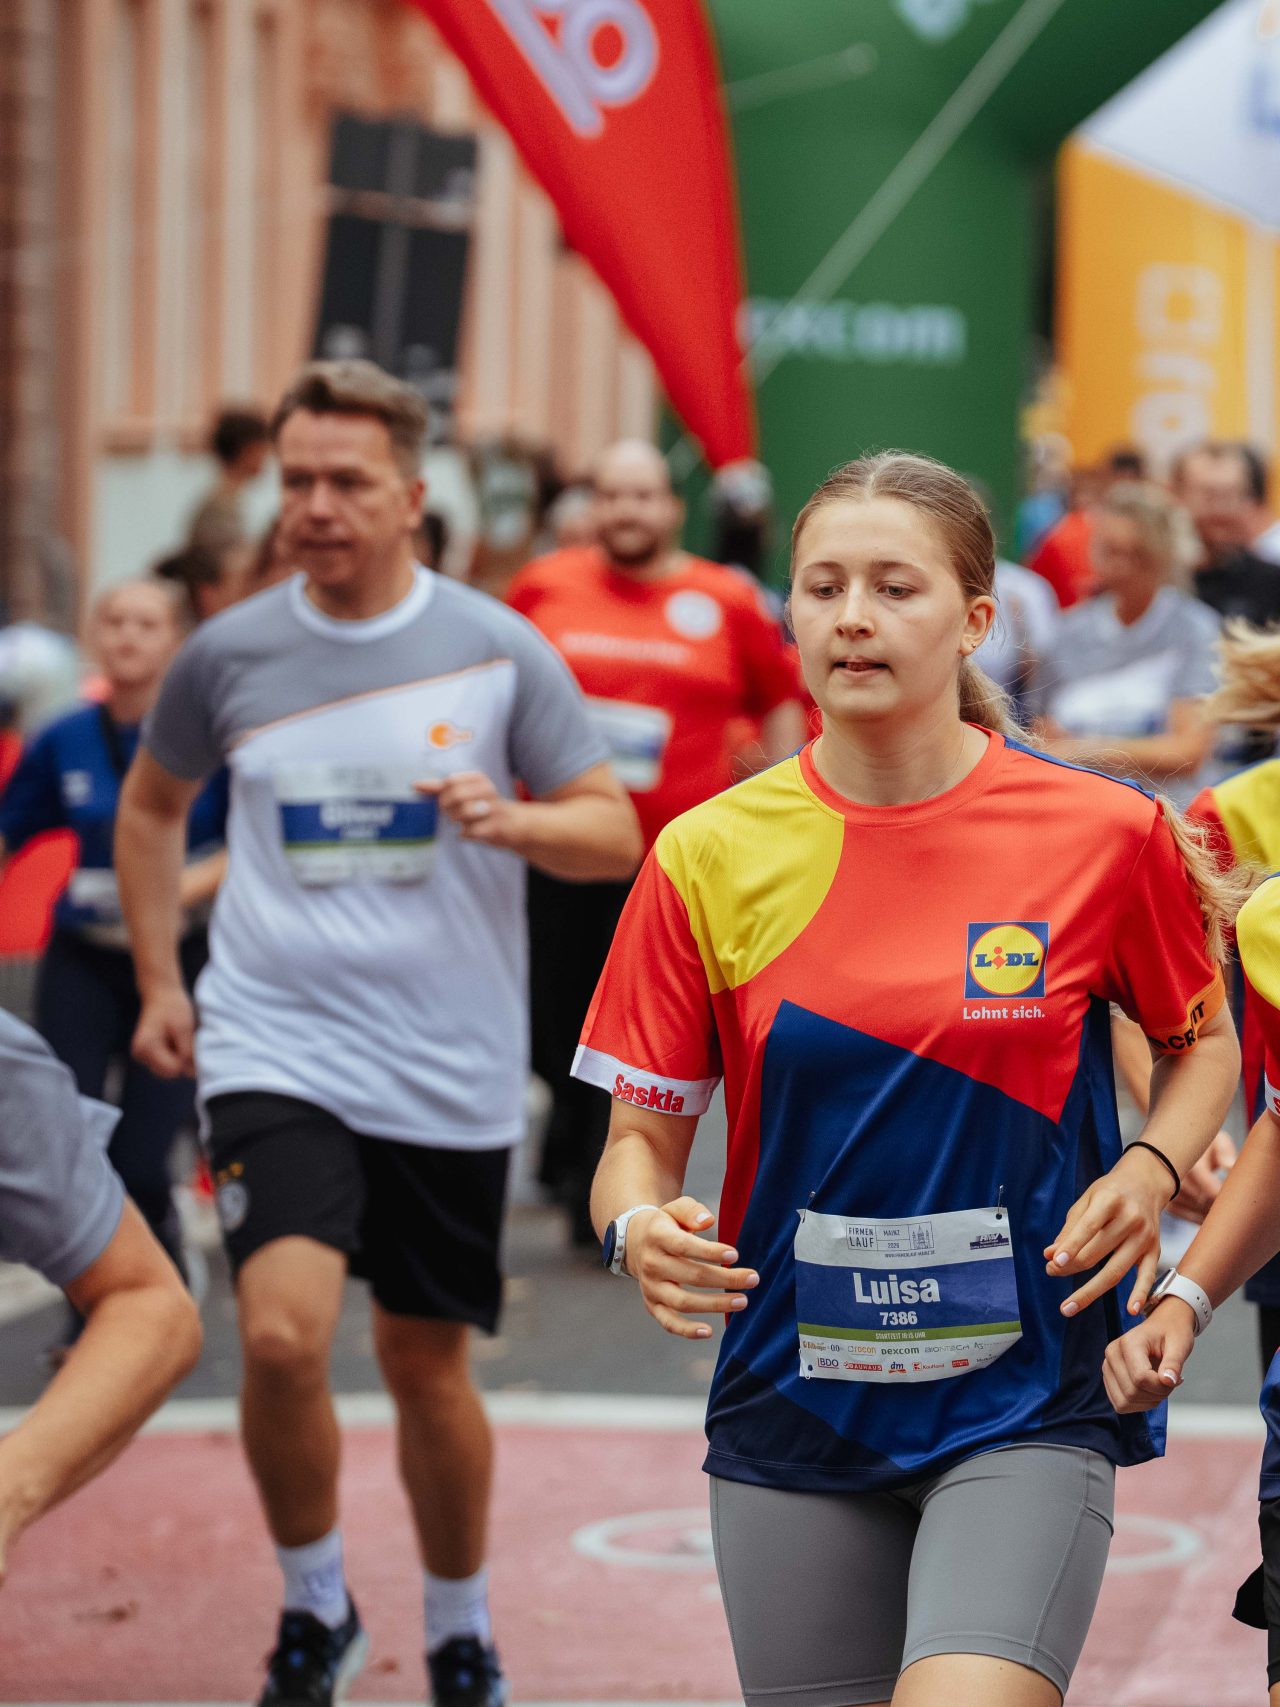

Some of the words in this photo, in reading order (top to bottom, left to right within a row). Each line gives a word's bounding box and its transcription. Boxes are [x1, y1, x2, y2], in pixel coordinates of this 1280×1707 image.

[963, 1006, 1008, 1020] Lohnt
[1012, 1005, 1045, 1019] sich.
[612, 1073, 685, 1113] Saskia
[848, 1227, 874, 1236] FIRMEN
[849, 1237, 874, 1248] LAUF
[852, 1272, 941, 1305] Luisa
[879, 1311, 918, 1326] 7386
[820, 1357, 839, 1367] BDO
[890, 1362, 904, 1370] dm
